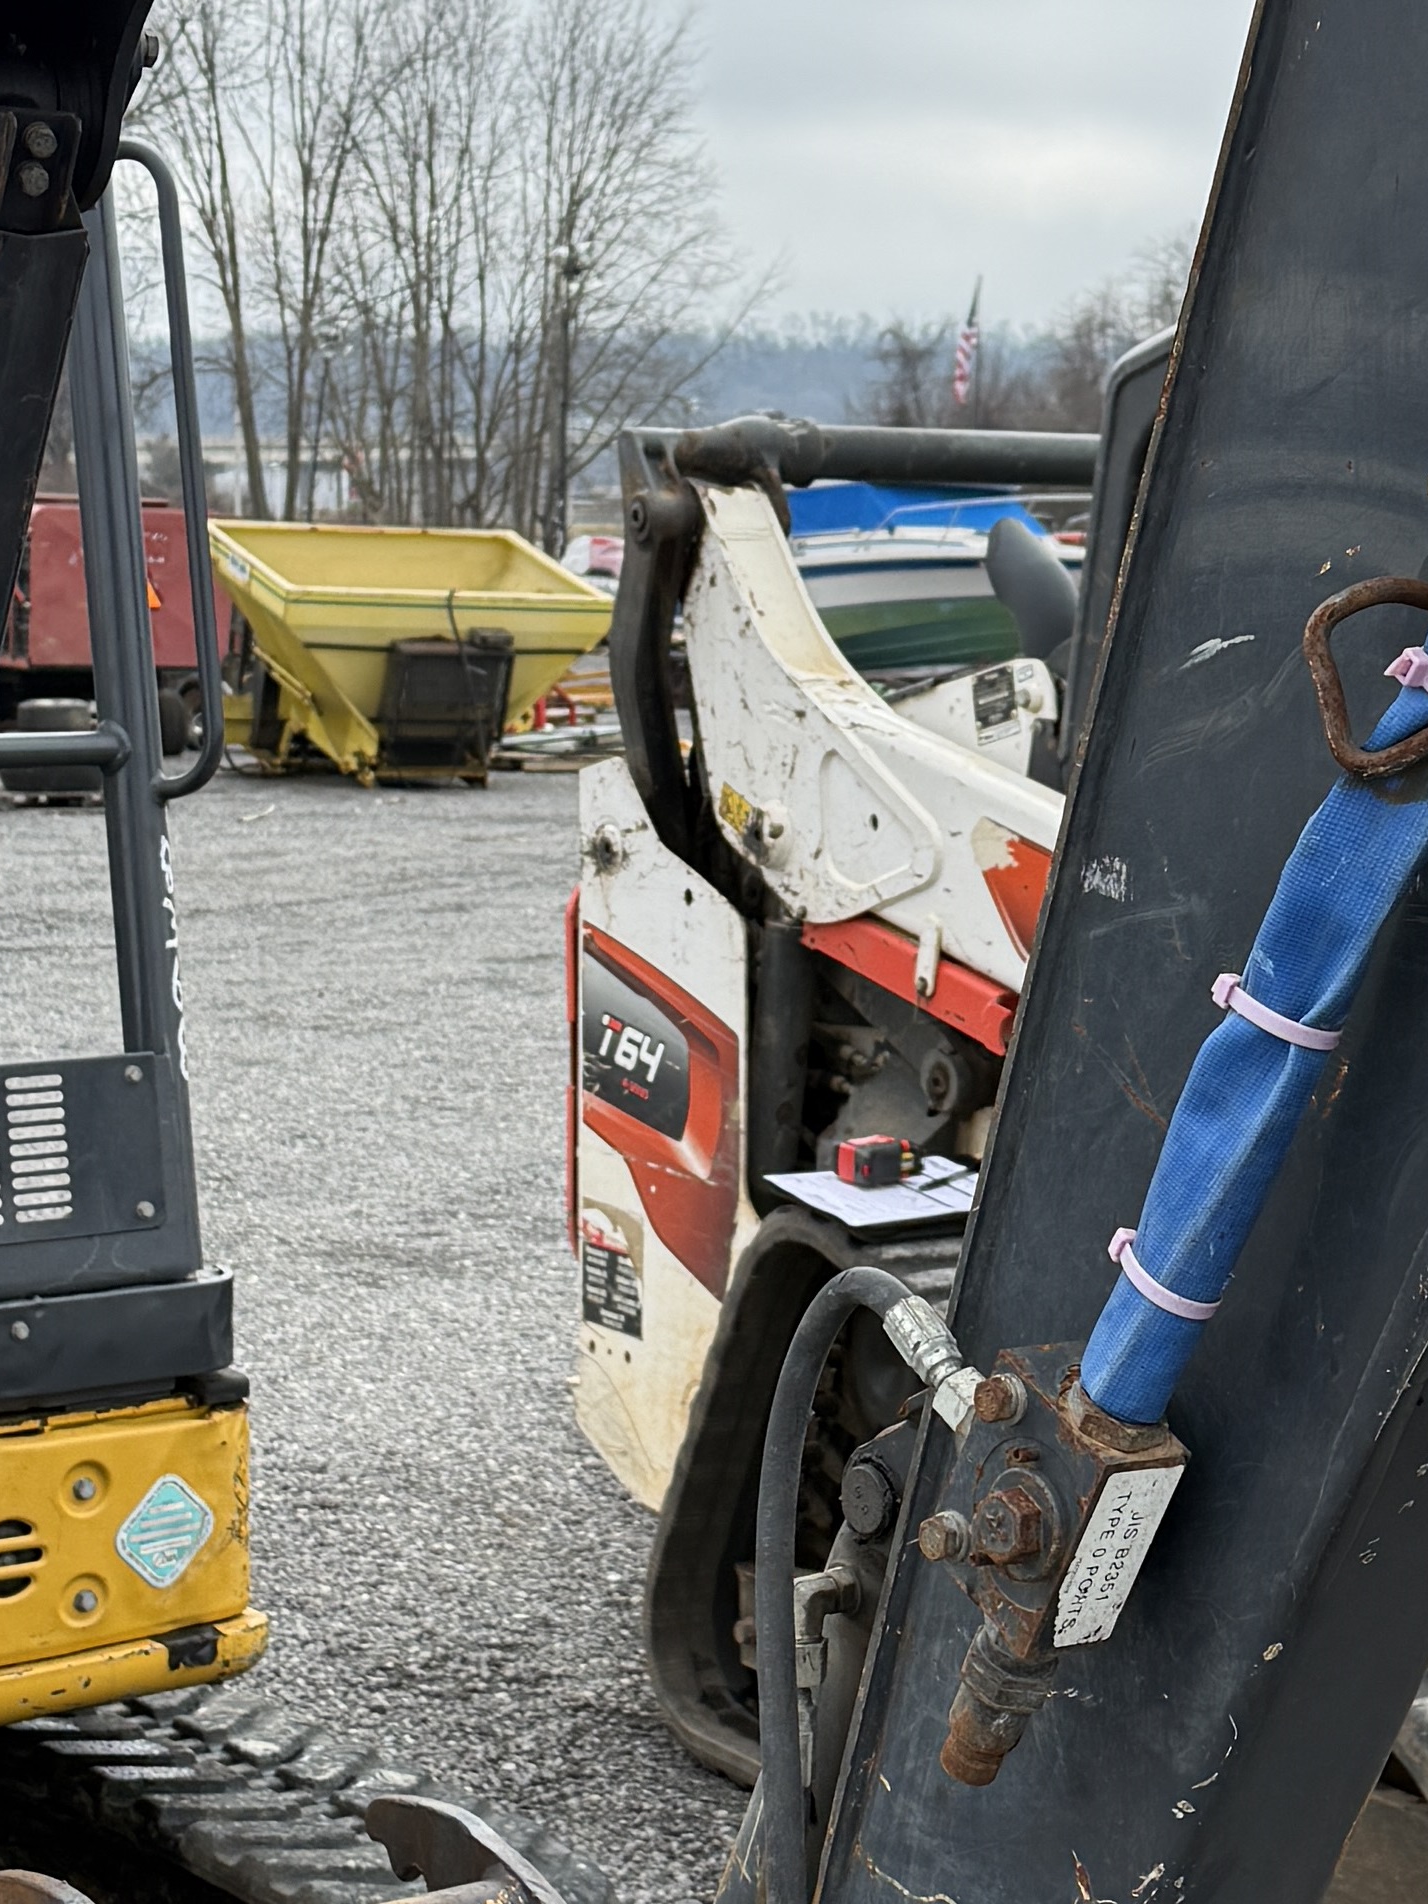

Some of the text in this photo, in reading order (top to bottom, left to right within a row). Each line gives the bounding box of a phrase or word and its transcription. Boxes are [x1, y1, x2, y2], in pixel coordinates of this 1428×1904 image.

[599, 1013, 665, 1083] T64
[1099, 1490, 1133, 1541] TYPE
[1095, 1511, 1144, 1602] JIS B2351
